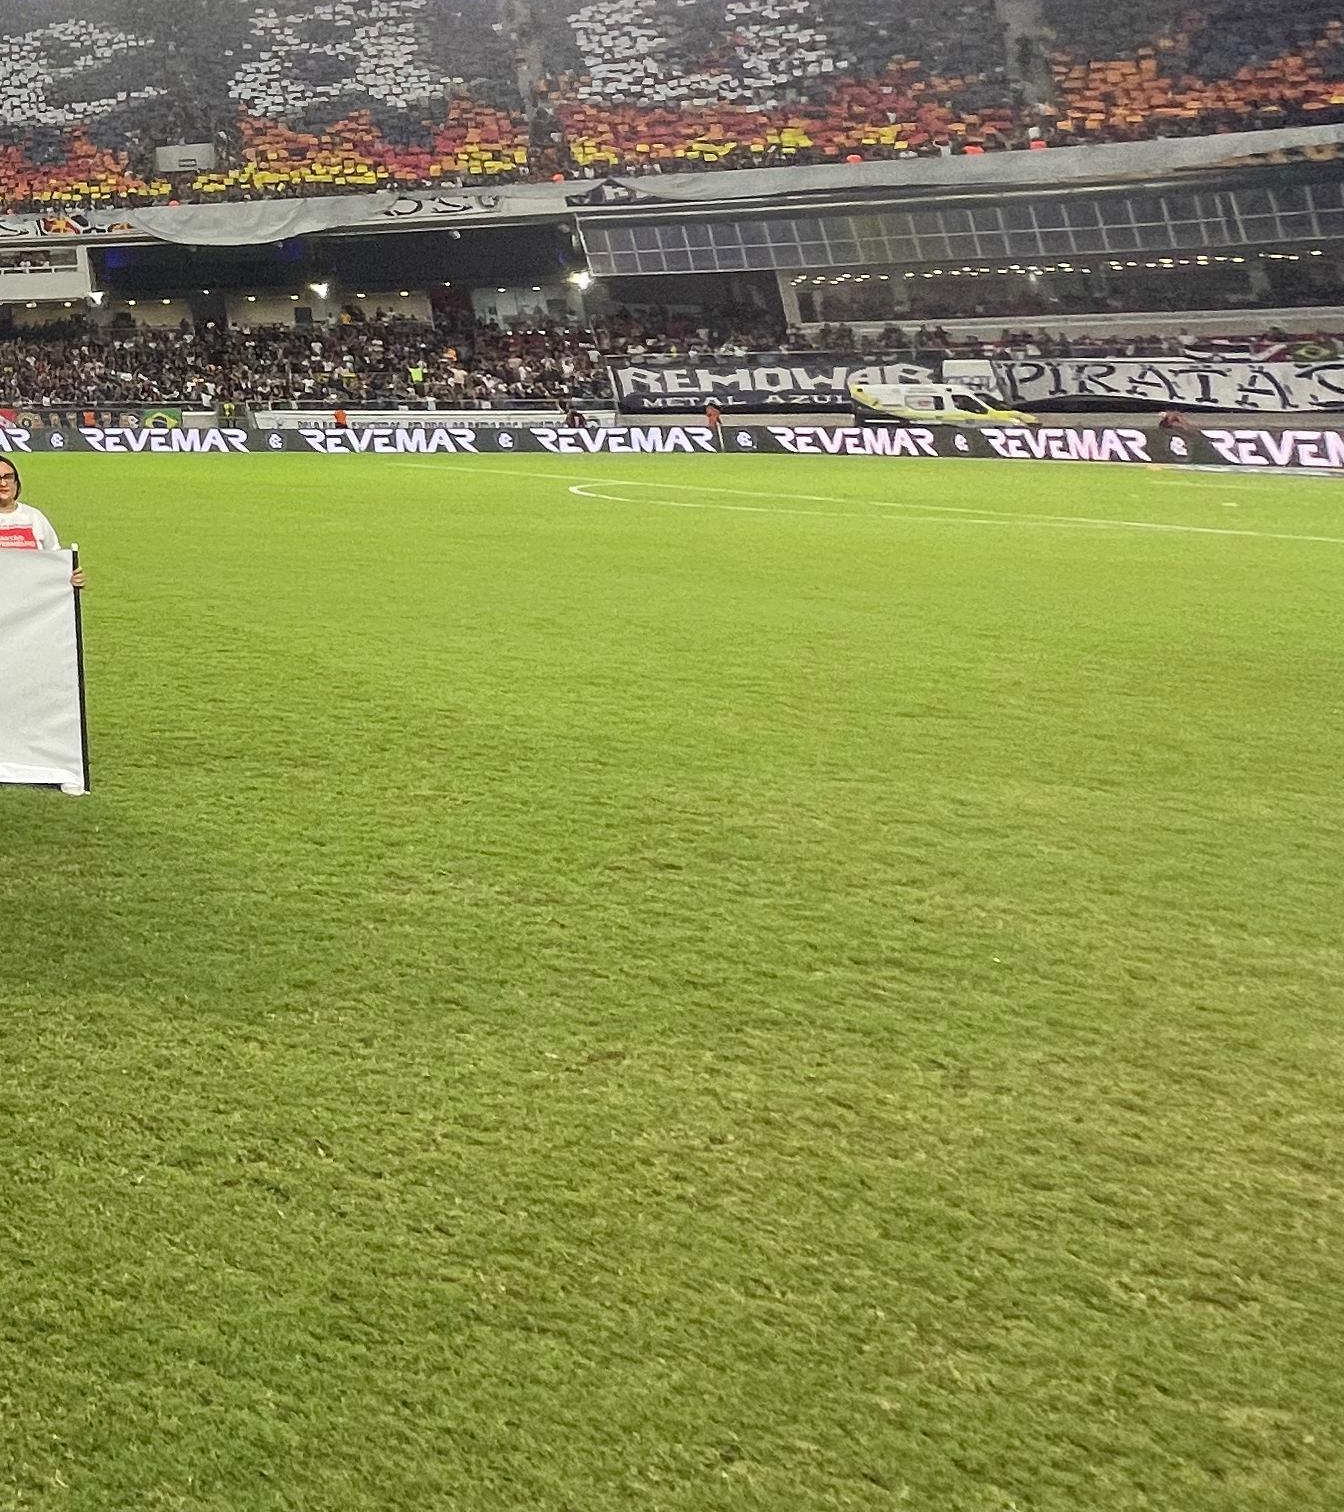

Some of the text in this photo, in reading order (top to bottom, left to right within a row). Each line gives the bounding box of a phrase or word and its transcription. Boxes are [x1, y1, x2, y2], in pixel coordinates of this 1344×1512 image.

[642, 393, 853, 408] METAL AZUL
[79, 428, 249, 453] REVEMAR
[298, 428, 480, 453] REVEMAR
[529, 426, 718, 453] REVEMAR
[767, 426, 940, 457] REVEMAR
[980, 428, 1152, 462] REVEMAR
